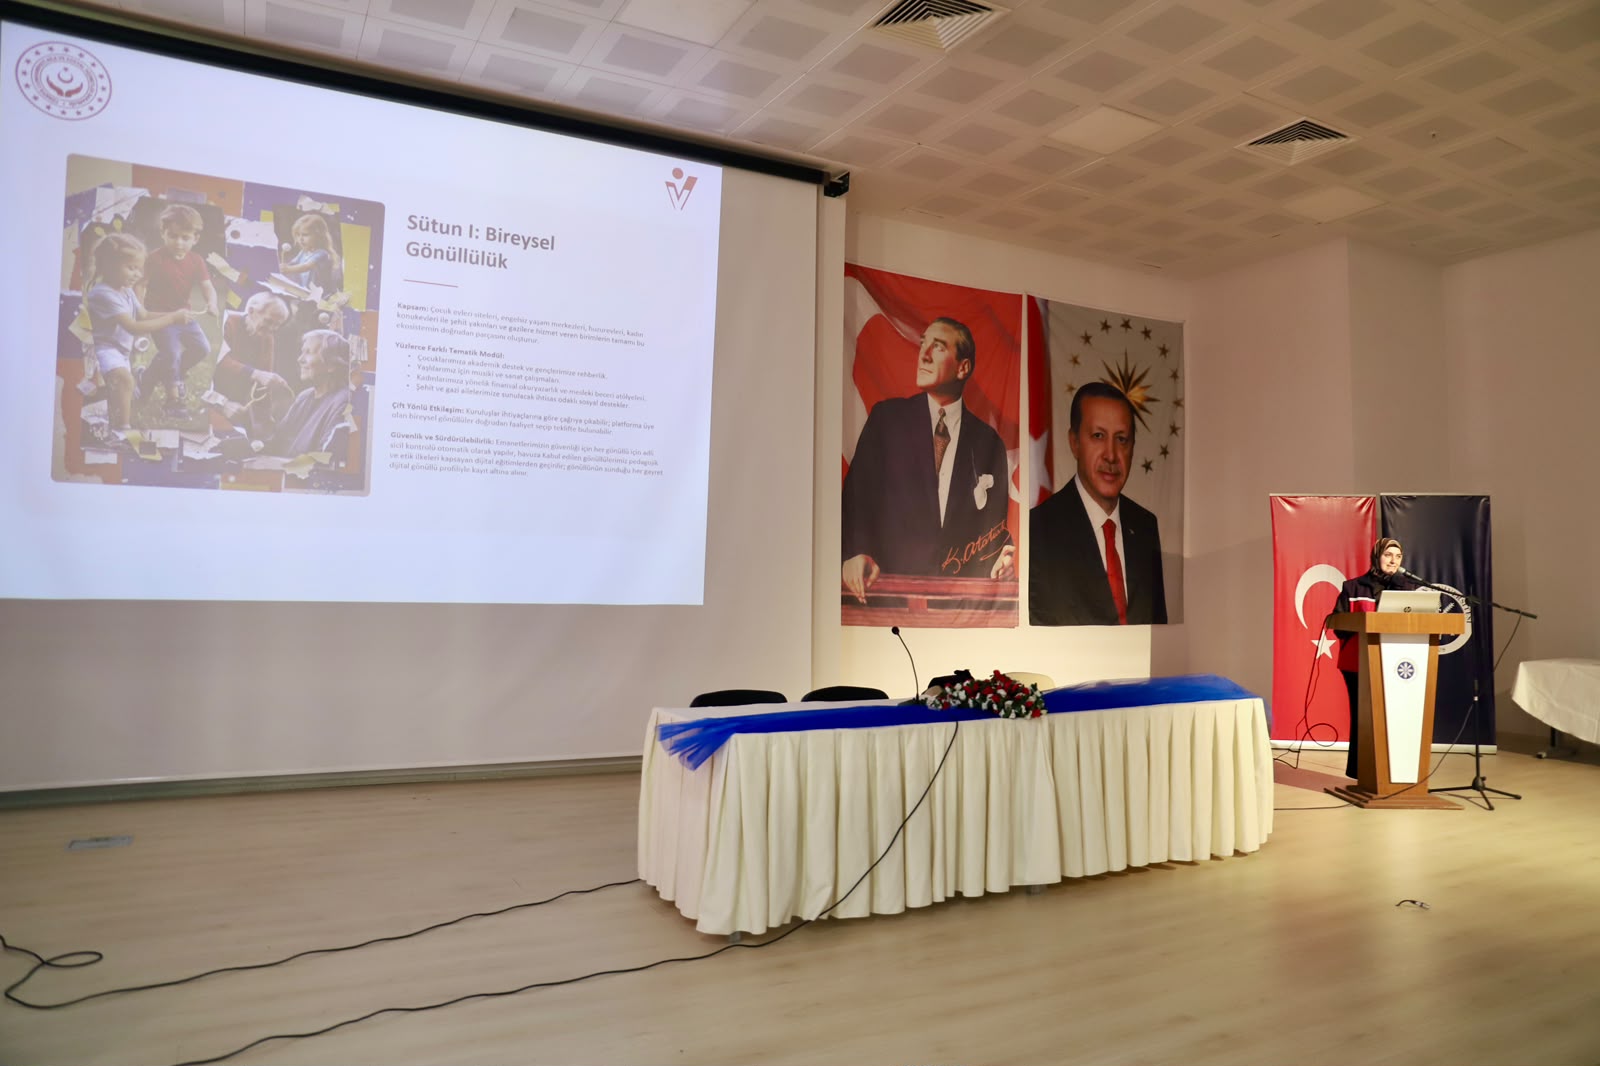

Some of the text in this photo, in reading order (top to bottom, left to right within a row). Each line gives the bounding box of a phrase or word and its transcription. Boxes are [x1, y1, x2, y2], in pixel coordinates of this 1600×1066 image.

[407, 214, 555, 250] Sütun I: Bireysel
[406, 241, 508, 269] Gönüllülük
[397, 302, 428, 313] Kapsam:
[430, 306, 451, 316] Çocuk
[529, 319, 550, 328] yaşam
[627, 329, 643, 337] kadın
[397, 312, 438, 323] konukevleri
[450, 318, 467, 328] şehit
[469, 320, 497, 331] yakınları
[508, 325, 534, 335] gazilere
[536, 328, 558, 337] hizmet
[580, 333, 610, 343] birimlerin
[612, 337, 635, 345] tamamı
[396, 321, 439, 333] ekosistemin
[440, 326, 474, 338] doğrudan
[476, 332, 506, 342] parçasını
[396, 341, 504, 359] Yüzlerce Farklı Tematik Modül:
[417, 354, 466, 366] Çocuklarımıza
[468, 359, 500, 368] akademik
[502, 362, 524, 371] destek
[535, 366, 576, 377] gençlerimize
[458, 368, 470, 376] için
[472, 368, 494, 377] musiki
[505, 372, 523, 380] sanat
[416, 383, 434, 393] Şehit
[446, 386, 459, 395] gazi
[461, 387, 500, 397] ailelerimize
[502, 391, 534, 400] sunulacak
[536, 394, 556, 402] ihtisas
[558, 396, 577, 404] odaklı
[579, 398, 598, 407] sosyal
[465, 378, 489, 388] yönelik
[519, 383, 558, 394] okuryazarlık
[595, 390, 614, 398] beceri
[392, 401, 405, 410] Çift
[407, 402, 428, 411] Yönlü
[466, 407, 500, 418] Kuruluşlar
[543, 414, 558, 422] göre
[612, 419, 642, 429] platforma
[643, 422, 654, 430] üye
[392, 411, 407, 419] olan
[409, 413, 437, 423] bireysel
[438, 415, 473, 426] gönüllüler
[475, 418, 508, 428] doğrudan
[536, 423, 552, 432] seçip
[554, 424, 576, 432] teklifte
[390, 431, 423, 440] Güvenlik
[496, 438, 549, 448] Emanetlerimizin
[551, 442, 580, 452] güvenliği
[581, 445, 592, 453] için
[606, 446, 629, 455] gönüllü
[631, 448, 641, 456] için
[390, 441, 404, 449] sicil
[406, 442, 436, 451] kontrolü
[438, 444, 468, 453] otomatik
[518, 450, 541, 458] havuza
[389, 461, 410, 470] dijital
[411, 462, 438, 472] gönüllü
[472, 466, 488, 475] kayıt
[416, 453, 439, 461] ilkeleri
[441, 454, 473, 464] kapsayan
[475, 457, 494, 466] dijital
[495, 458, 538, 468] eğitimlerden
[567, 462, 603, 472] gönüllünün
[605, 465, 631, 474] sunduğu
